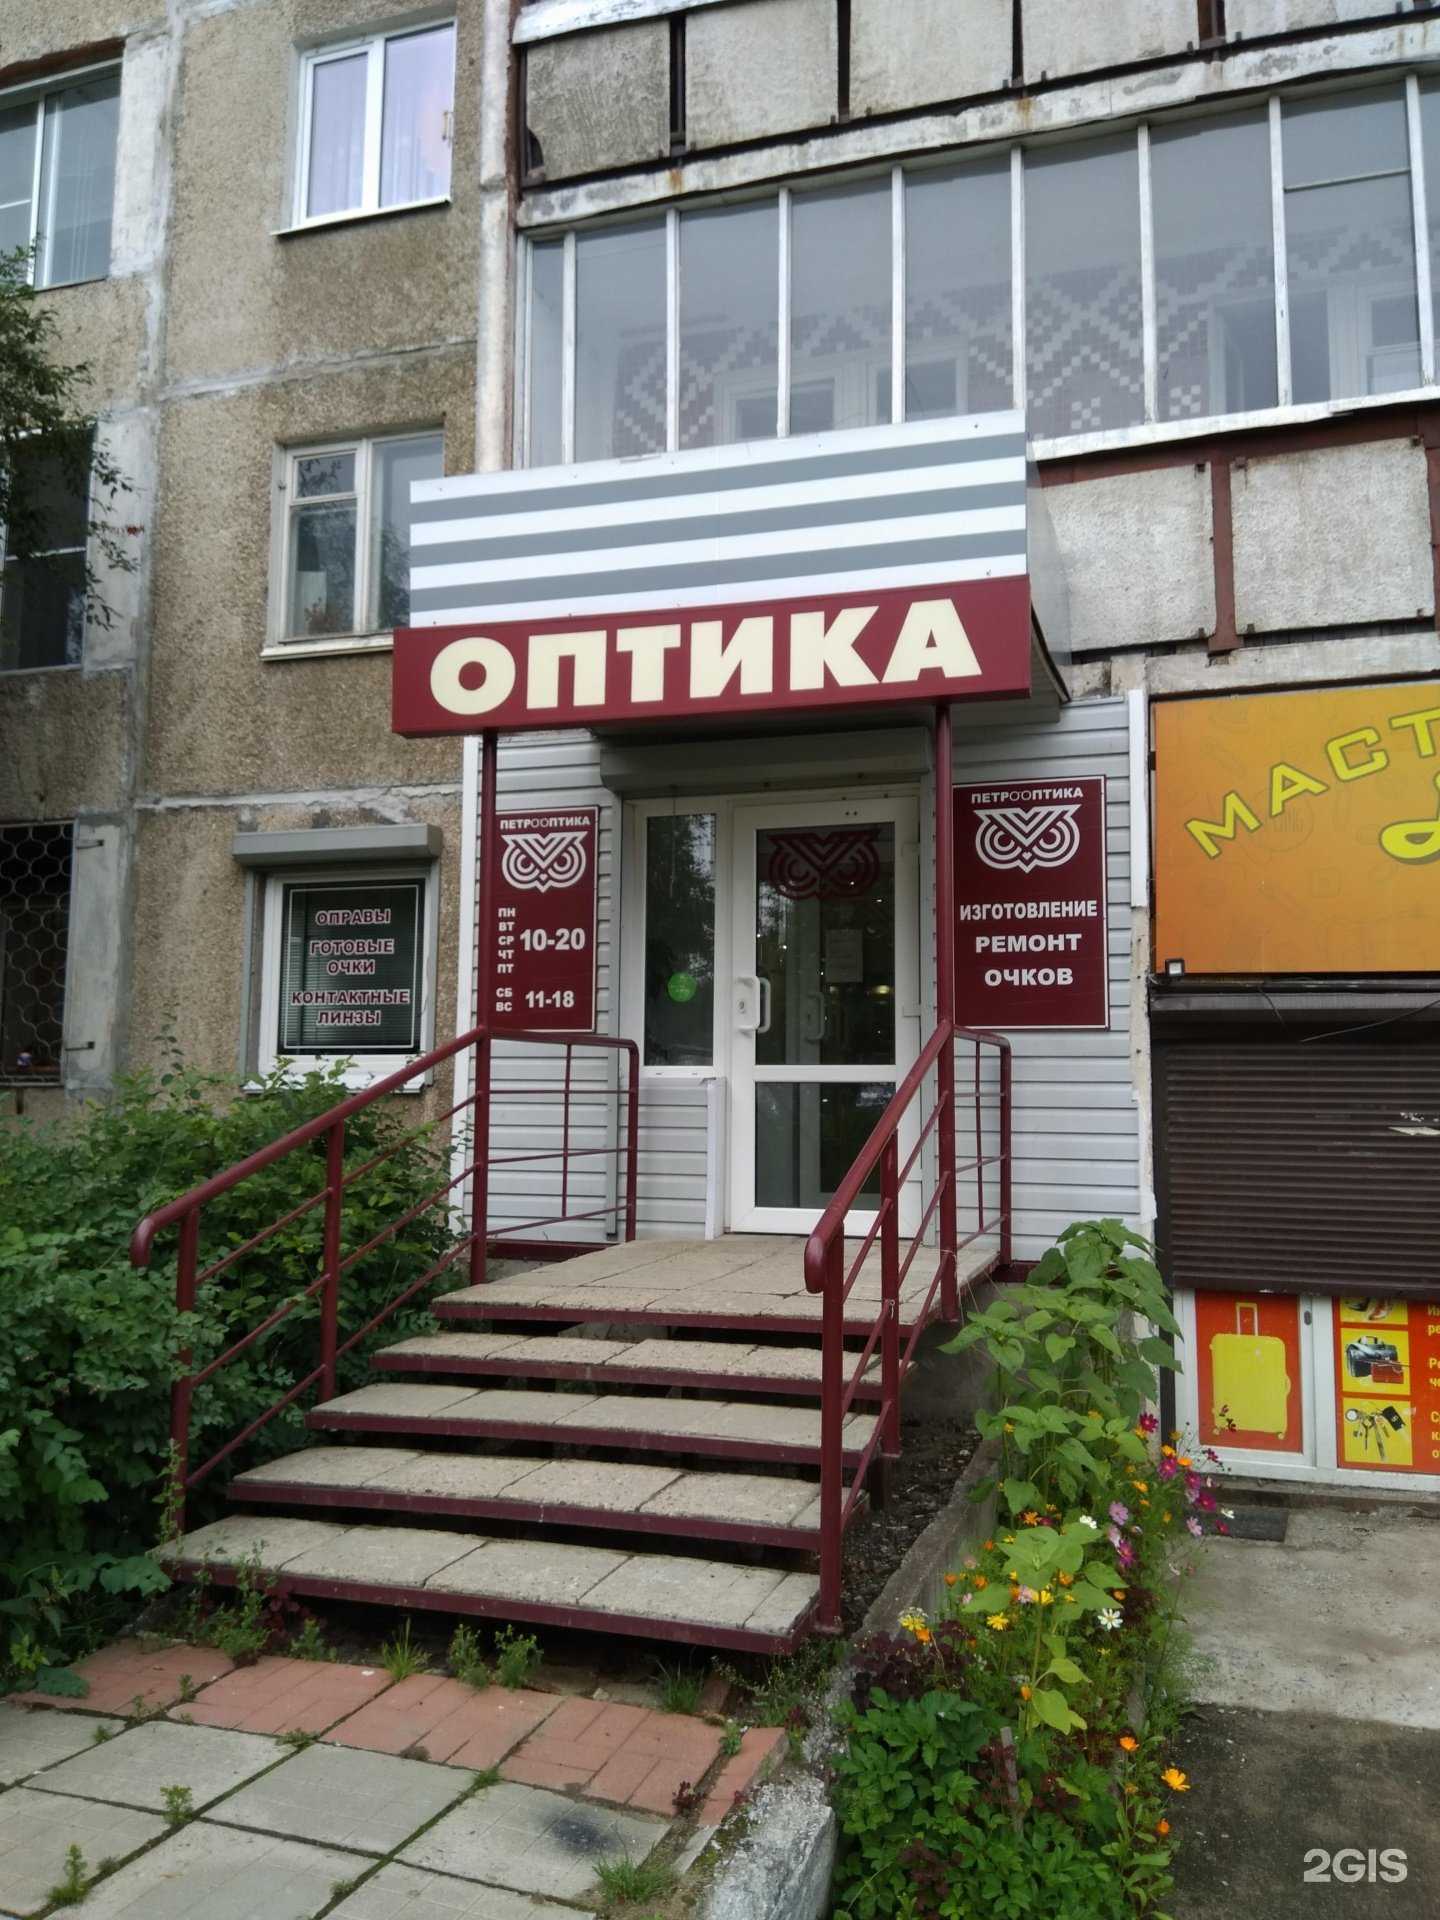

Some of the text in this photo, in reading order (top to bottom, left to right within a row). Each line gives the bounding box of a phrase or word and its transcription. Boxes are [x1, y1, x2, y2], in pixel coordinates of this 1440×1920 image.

[430, 598, 982, 716] ОПТИКА
[315, 909, 391, 925] ОПРАВЫ
[498, 908, 515, 918] ПН
[960, 900, 1098, 921] ИЗГОТОВЛЕНИЕ
[499, 922, 514, 932] ВТ
[498, 928, 585, 951] СР 10-20
[975, 934, 1082, 953] РЕМОНТ
[310, 939, 394, 956] ГОТОВЫЕ
[498, 950, 514, 959] ЧТ
[328, 960, 375, 975] ОЧКИ
[497, 963, 514, 973] ПТ
[984, 968, 1073, 986] ОЧКОВ
[291, 990, 410, 1005] КОНТАКТНЫЕ
[496, 988, 512, 998] СБ
[525, 991, 574, 1008] 11-18
[496, 1002, 512, 1012] ВС
[317, 1011, 381, 1026] ЛИНЗЫ
